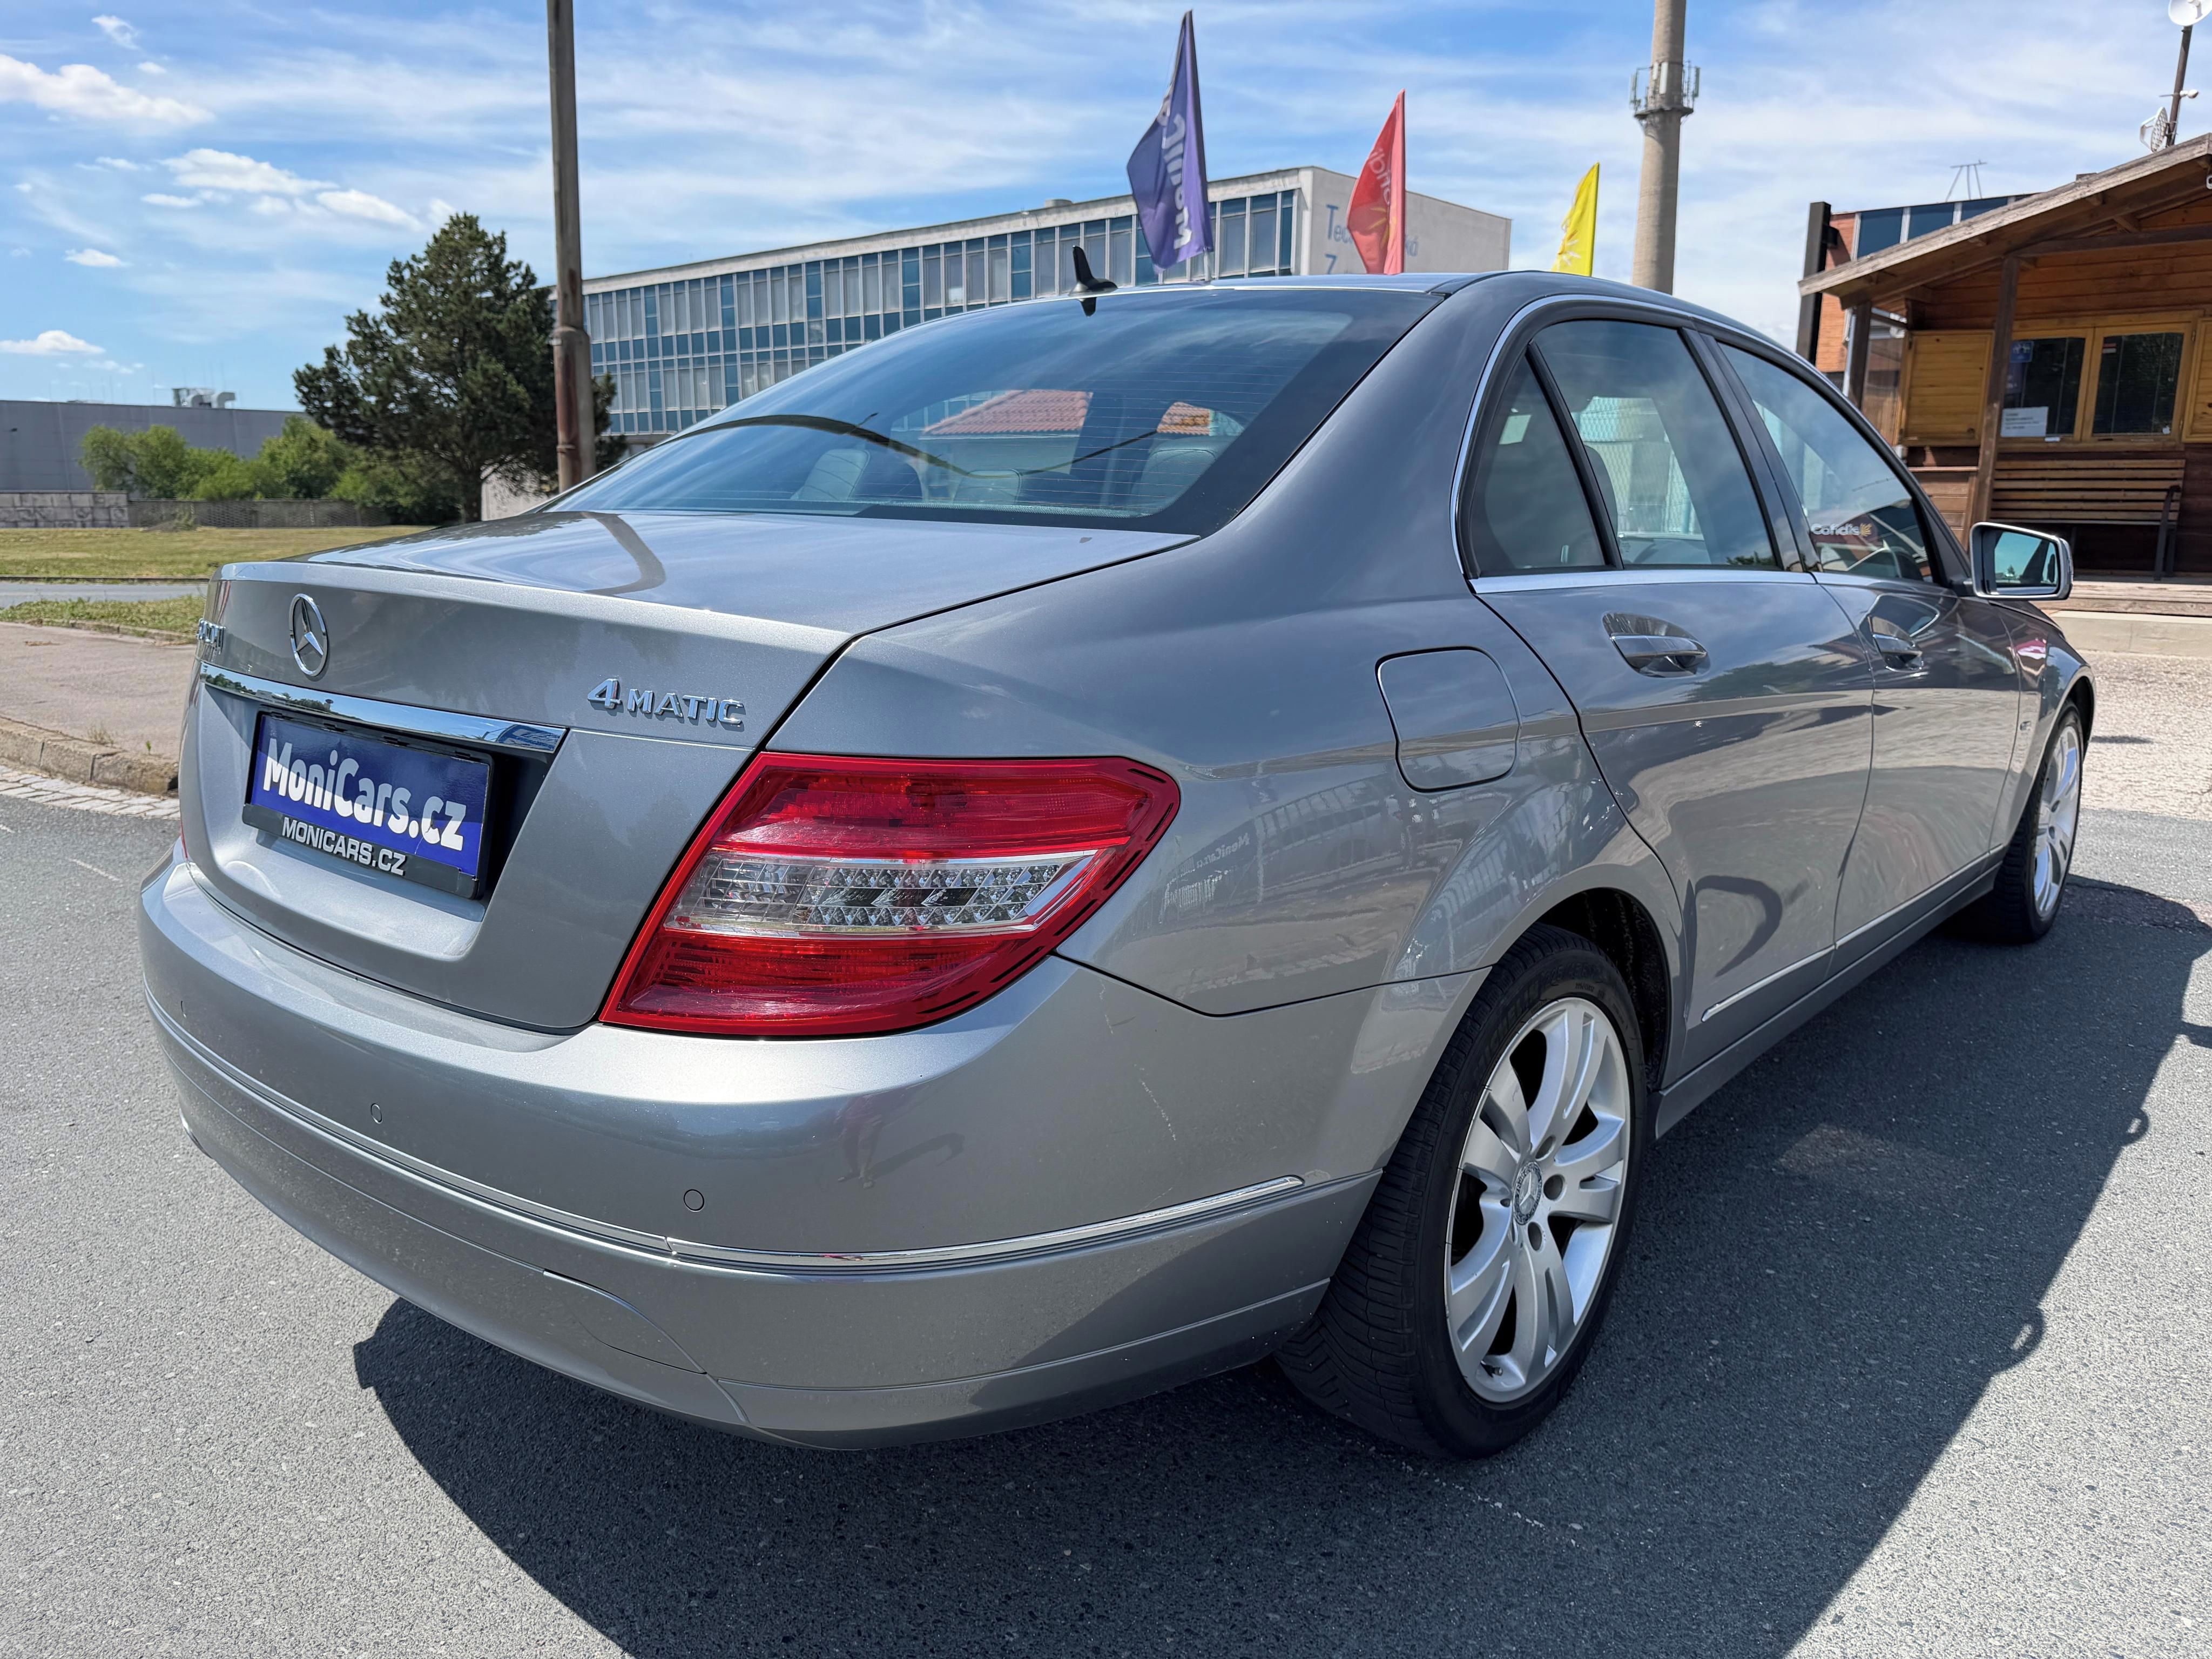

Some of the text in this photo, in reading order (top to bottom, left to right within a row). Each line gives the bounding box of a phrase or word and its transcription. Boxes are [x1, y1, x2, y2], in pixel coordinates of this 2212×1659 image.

[1810, 523, 1860, 536] Cofidis
[587, 678, 744, 725] 4MATIC
[263, 738, 467, 851] MoniCars.cz
[282, 816, 406, 876] MONICARS.CZ
